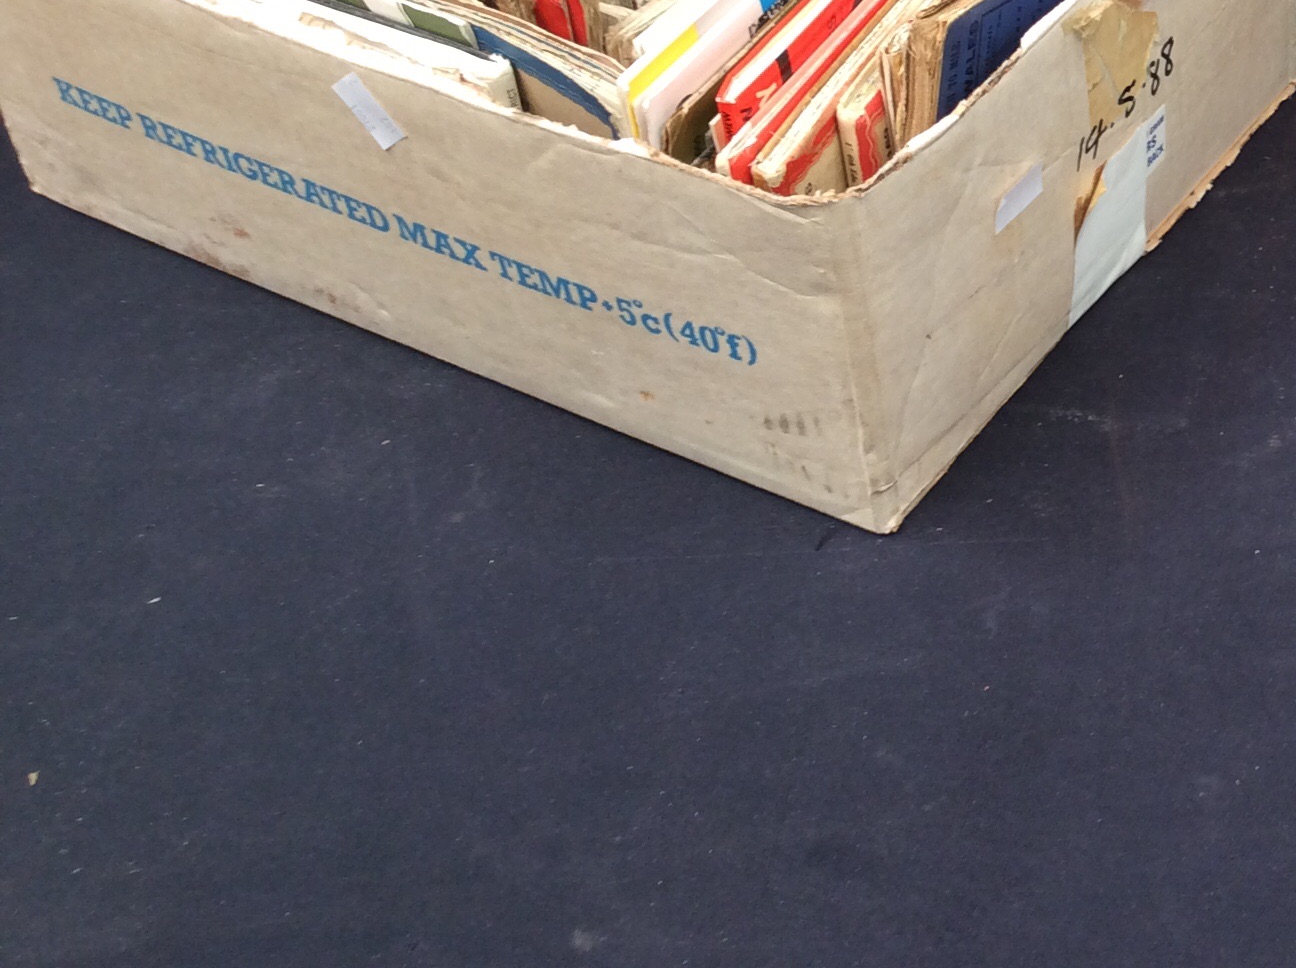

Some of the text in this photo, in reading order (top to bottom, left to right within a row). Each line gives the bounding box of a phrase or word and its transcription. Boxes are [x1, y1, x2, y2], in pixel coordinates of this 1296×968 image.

[52, 76, 132, 129] KEEP
[135, 112, 390, 233] REFRIGERATED
[392, 213, 489, 271] MAX
